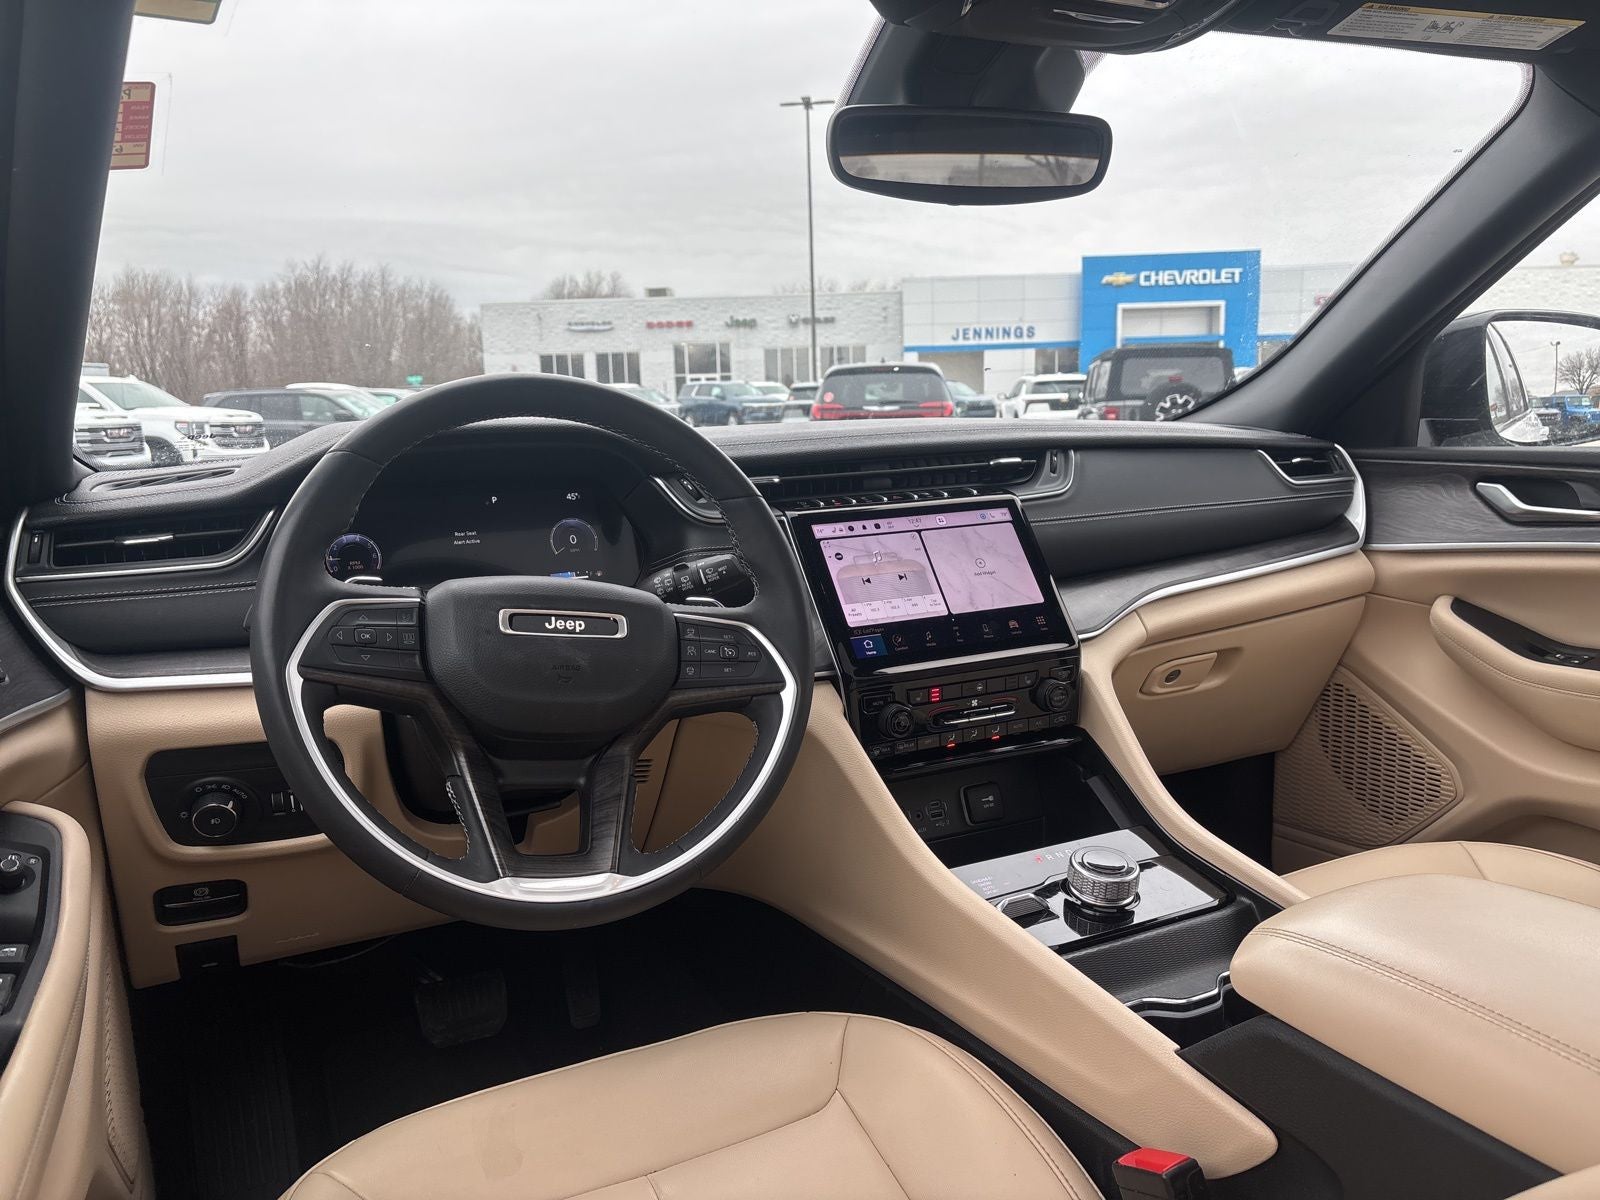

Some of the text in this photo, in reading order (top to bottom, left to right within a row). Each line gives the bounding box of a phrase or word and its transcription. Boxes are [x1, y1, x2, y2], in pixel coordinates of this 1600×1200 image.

[1138, 267, 1243, 286] CHEVROLET
[952, 325, 1036, 341] JENNINGS
[491, 496, 498, 504] P
[569, 534, 577, 544] 0
[545, 616, 586, 633] Jeep
[360, 632, 371, 640] OK
[232, 788, 248, 799] AUTO
